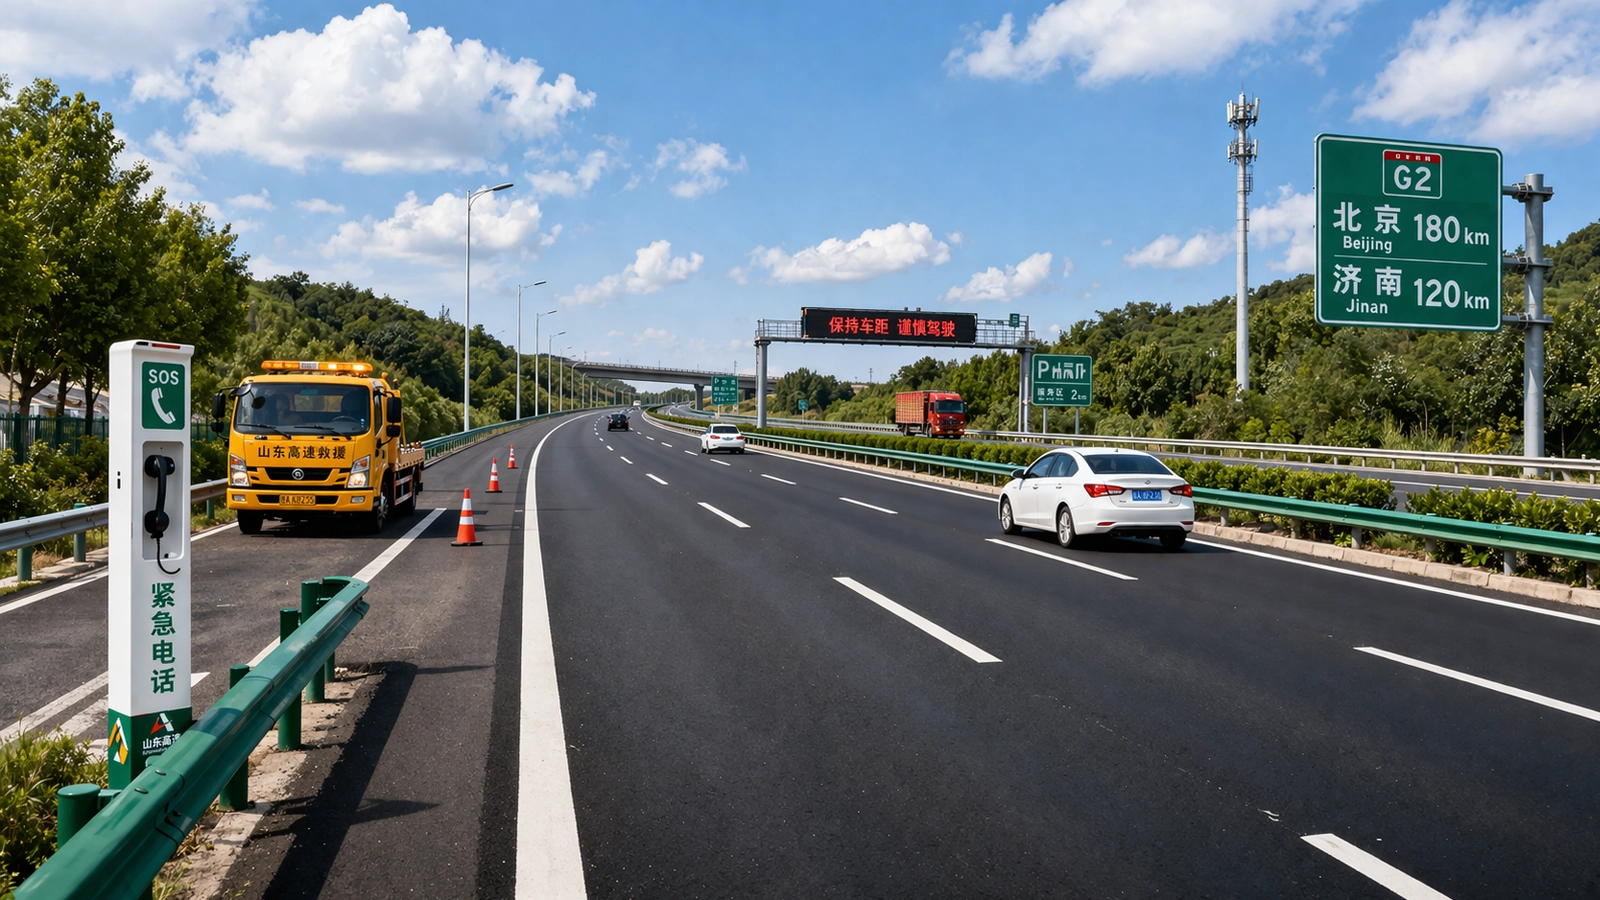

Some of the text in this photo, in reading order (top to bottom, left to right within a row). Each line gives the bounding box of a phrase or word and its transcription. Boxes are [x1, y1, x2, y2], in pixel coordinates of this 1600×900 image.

[1394, 164, 1431, 192] G2
[1333, 201, 1489, 245] 北京 180 km
[1343, 235, 1392, 254] Beijing
[1333, 263, 1489, 309] 济南 120 km
[1346, 298, 1388, 314] Jinan
[829, 316, 889, 335] 保持车距
[148, 368, 179, 386] SOS
[1071, 389, 1078, 400] 2
[258, 445, 346, 460] 山东高速救援
[150, 582, 176, 694] 紧急电话
